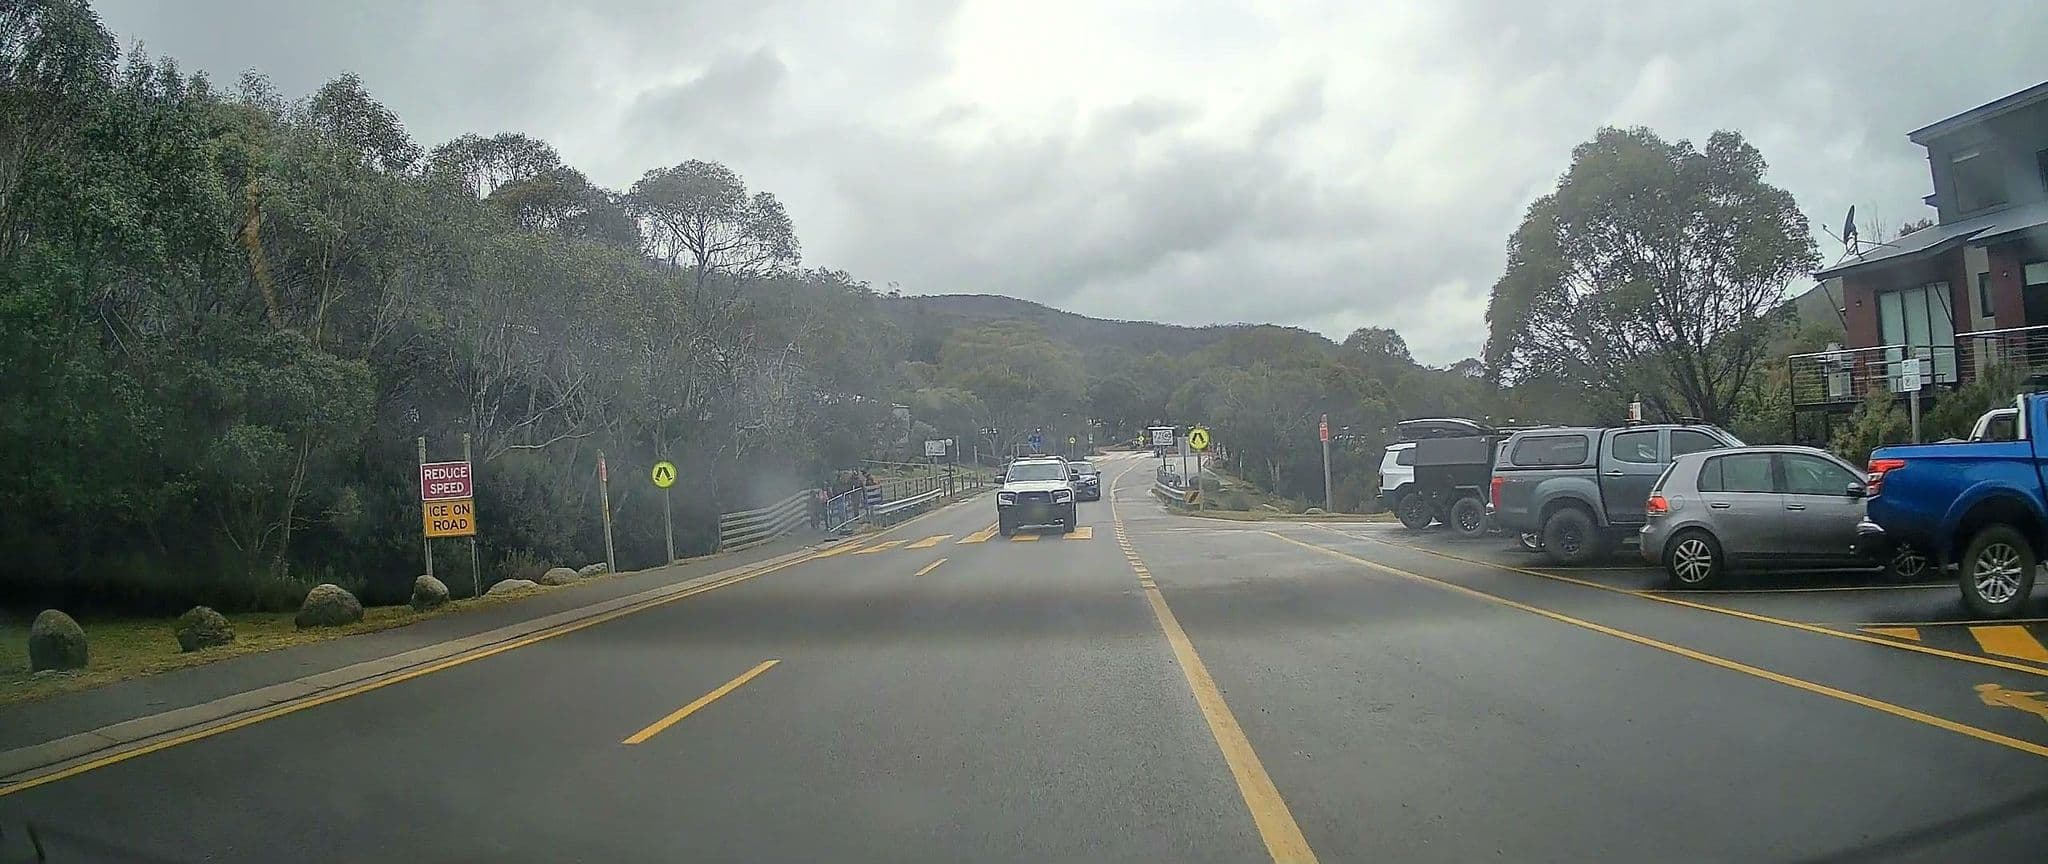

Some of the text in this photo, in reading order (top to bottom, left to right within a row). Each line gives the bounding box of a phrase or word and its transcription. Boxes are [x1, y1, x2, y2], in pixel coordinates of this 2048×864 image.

[424, 467, 468, 480] REDUCE
[430, 482, 464, 494] SPEED
[429, 504, 470, 517] ICE ON
[433, 519, 468, 531] ROAD
